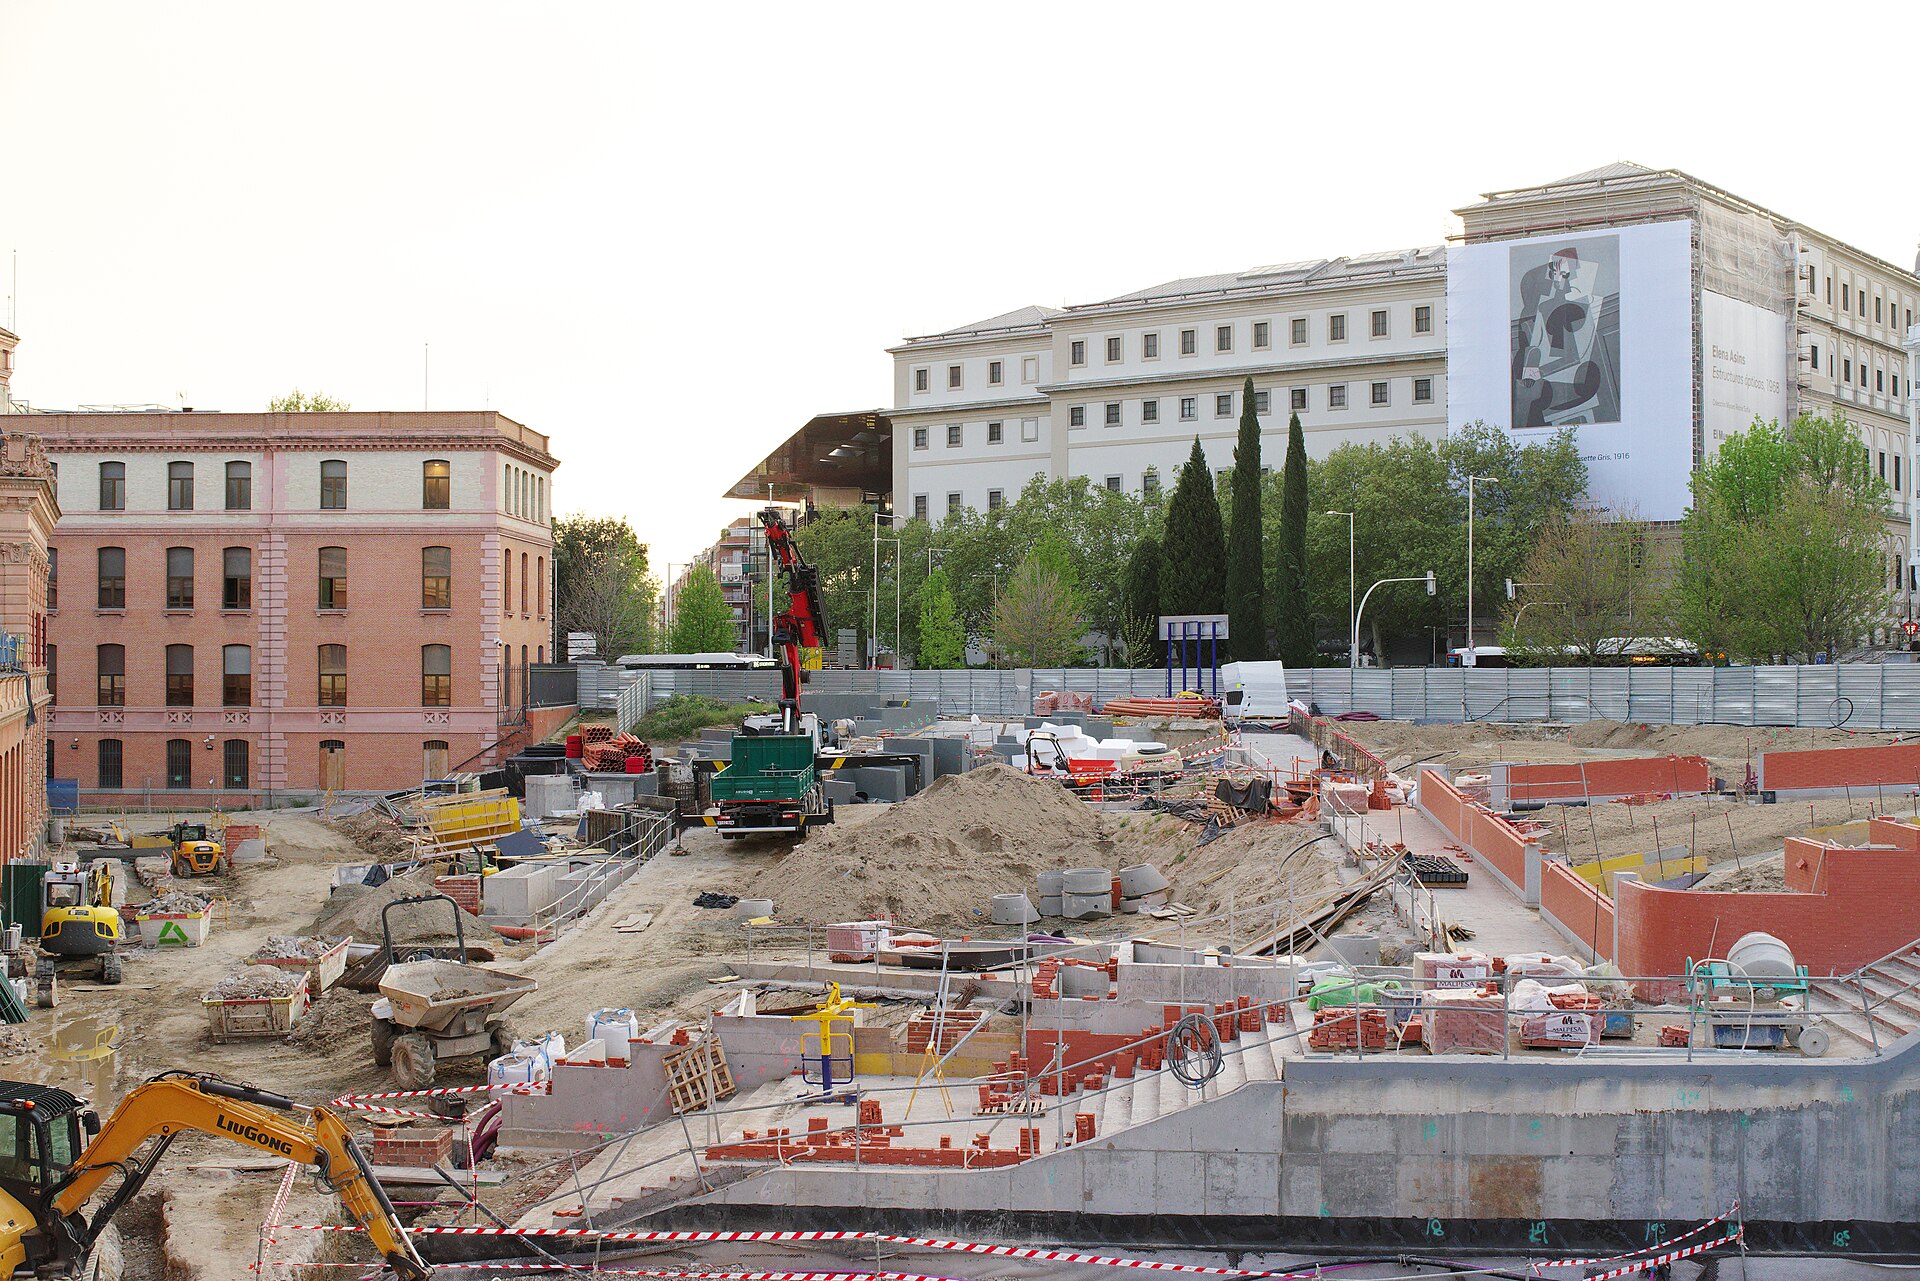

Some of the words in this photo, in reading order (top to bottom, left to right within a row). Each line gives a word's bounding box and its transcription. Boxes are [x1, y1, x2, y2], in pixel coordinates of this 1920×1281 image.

[1712, 345, 1729, 360] Elena
[1729, 349, 1745, 365] Asins
[1766, 379, 1780, 394] 1968
[1613, 452, 1630, 460] 1916
[1553, 1025, 1582, 1033] MALPESA
